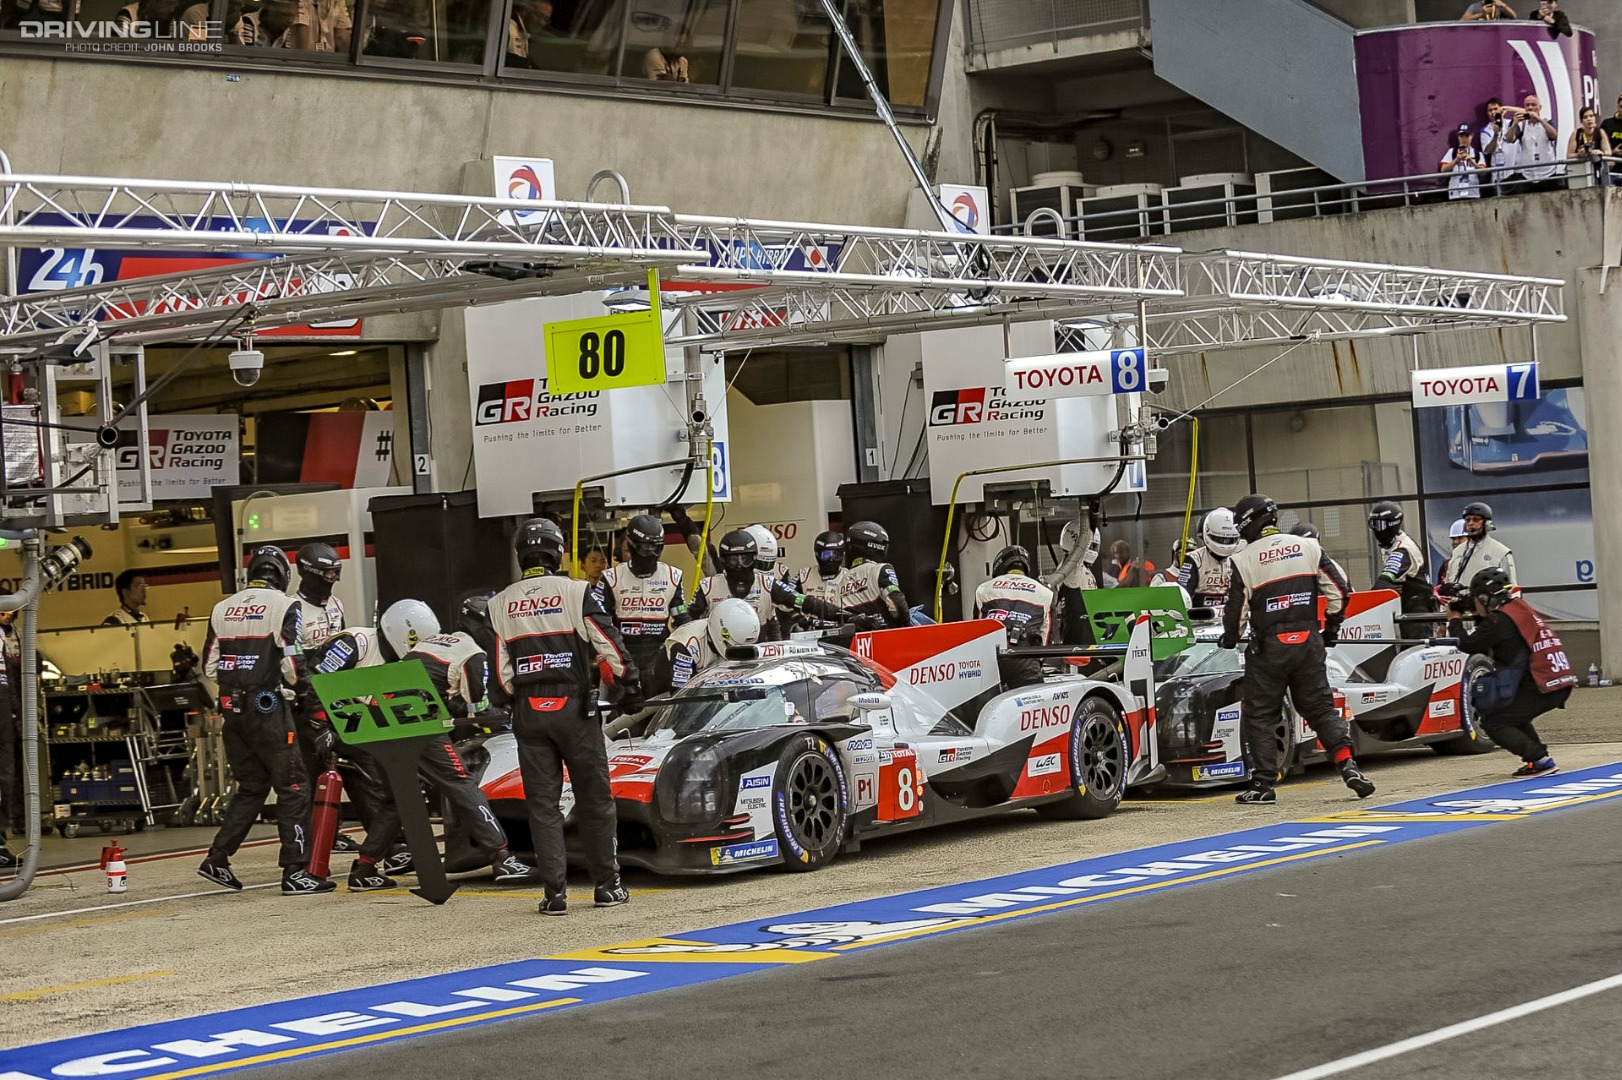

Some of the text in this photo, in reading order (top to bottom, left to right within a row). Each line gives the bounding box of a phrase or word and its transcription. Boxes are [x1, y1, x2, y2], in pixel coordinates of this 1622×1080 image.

[27, 247, 104, 290] 24h
[578, 329, 626, 380] 80
[1013, 351, 1140, 390] TOYOTA 8
[1419, 365, 1532, 399] TOYOTA 7
[477, 396, 531, 424] GR
[536, 402, 598, 418] Racing
[932, 402, 984, 424] GR
[986, 408, 1044, 421] Racing
[174, 430, 232, 441] TOYOTA
[483, 424, 602, 443] Pushing the limits for Better
[937, 426, 1048, 442] Pushing the limits for Better
[171, 443, 226, 454] GAZOO
[169, 456, 223, 470] Racing
[869, 451, 875, 464] 1
[418, 457, 426, 473] 2
[1259, 543, 1301, 562] DENSO
[992, 580, 1037, 590] DENSO
[508, 595, 562, 614] DENSO
[621, 597, 665, 607] DENSO
[1267, 601, 1289, 611] GR
[508, 607, 563, 620] TOYOTA HYBRID
[620, 627, 641, 636] GR
[1363, 624, 1382, 632] TOYOTA
[760, 644, 785, 657] ZENT
[857, 637, 872, 658] HY
[518, 662, 542, 673] GR
[958, 660, 981, 669] TOYOTA
[1546, 651, 1570, 673] 349
[909, 663, 955, 685] DENSO
[958, 669, 982, 680] HYBRID
[1423, 658, 1462, 681] DENSO
[1020, 704, 1070, 731] DENSO
[1219, 711, 1239, 720] AISIN
[847, 739, 873, 751] RAYS
[891, 749, 916, 758] TOTAL
[940, 754, 955, 762] GR
[1036, 755, 1057, 769] WEC
[1210, 765, 1241, 775] MICHELIN
[745, 776, 770, 788] AISIN
[858, 778, 872, 800] P1
[898, 767, 914, 811] 8
[734, 845, 774, 858] MICHELIN
[107, 877, 113, 887] 8
